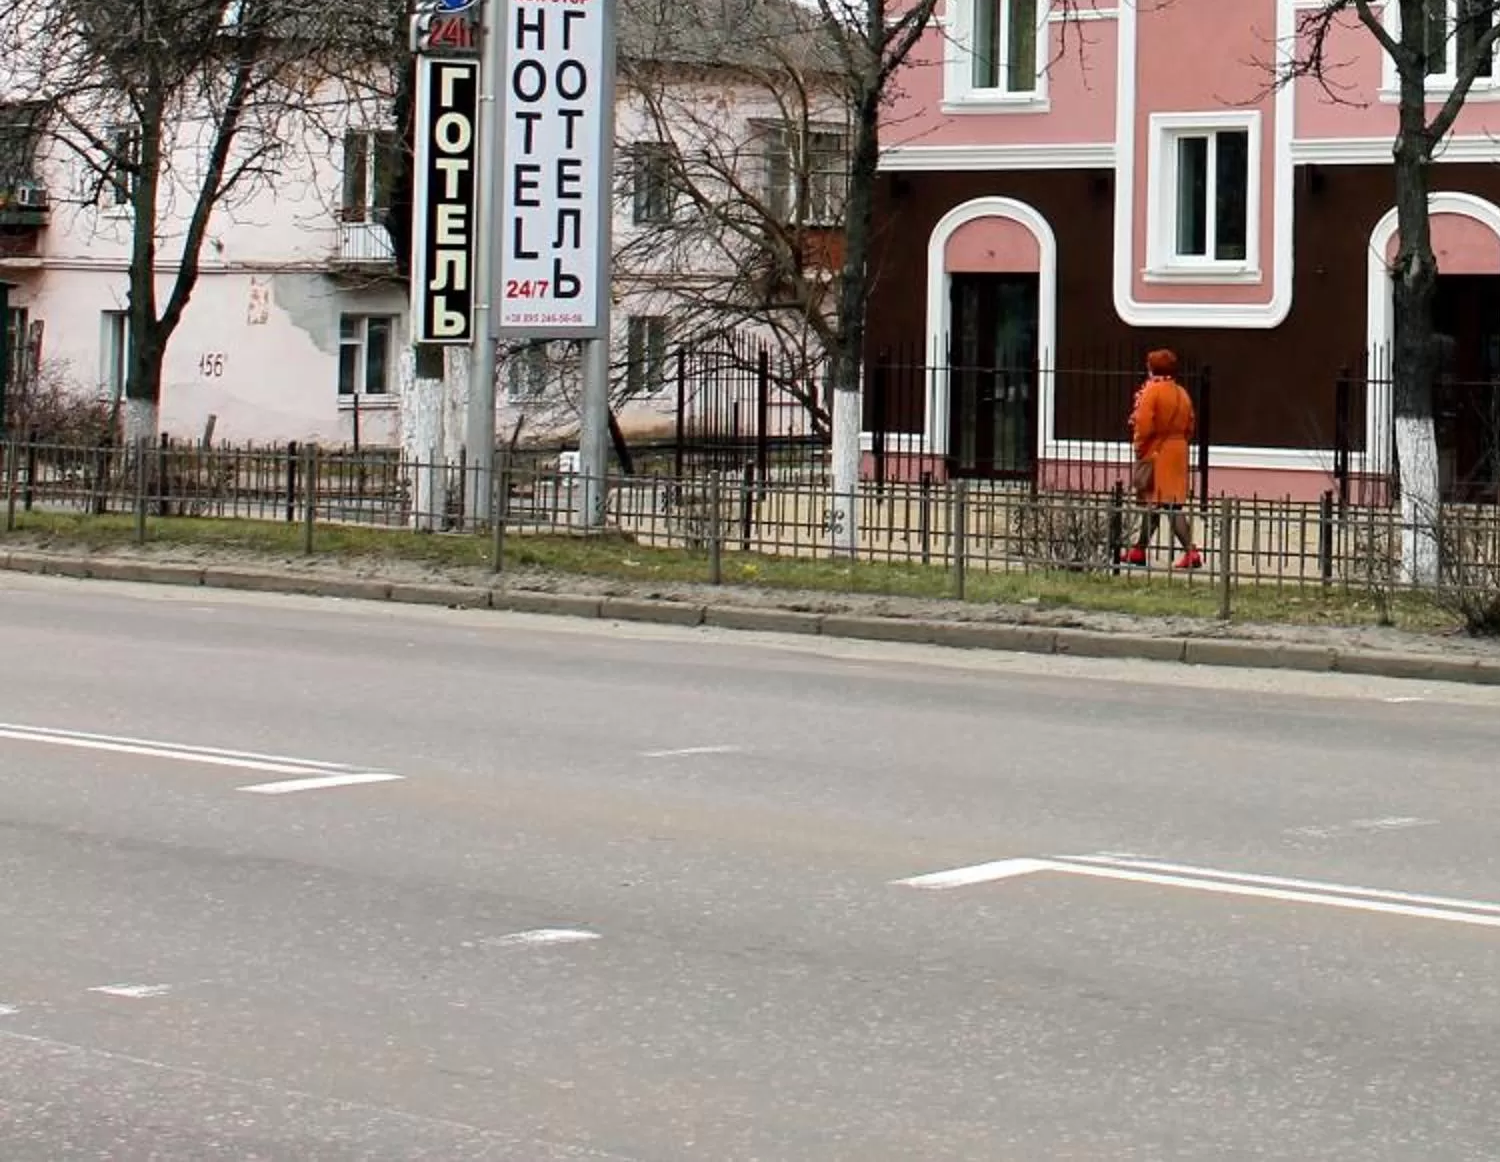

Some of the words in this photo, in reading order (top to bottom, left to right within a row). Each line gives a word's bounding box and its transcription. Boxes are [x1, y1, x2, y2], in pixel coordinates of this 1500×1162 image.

[429, 67, 472, 338] ГОТЕЛЬ
[512, 7, 547, 260] HOTEL
[552, 9, 588, 299] ГОТЕЛЬ
[506, 280, 549, 299] 24/7
